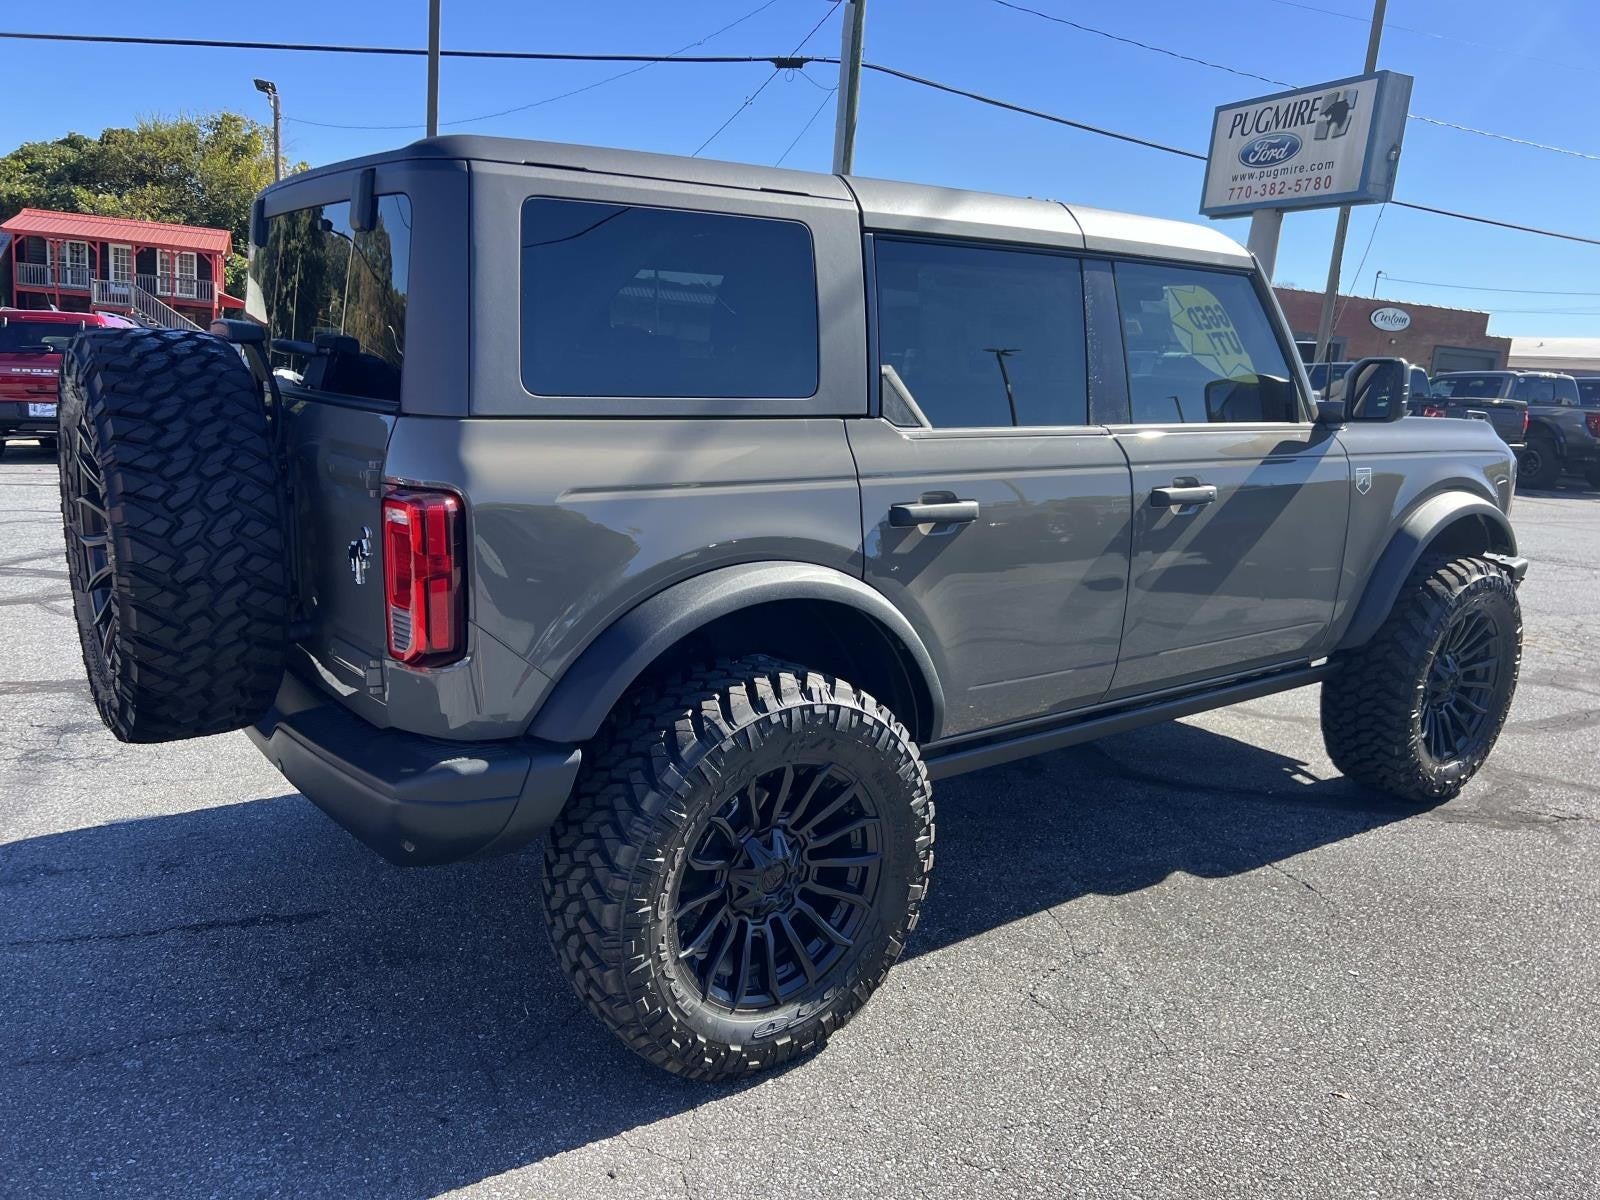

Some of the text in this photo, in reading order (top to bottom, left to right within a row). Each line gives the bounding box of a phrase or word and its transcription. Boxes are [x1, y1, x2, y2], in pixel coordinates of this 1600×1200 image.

[1228, 97, 1322, 139] PUGMIRE
[1249, 138, 1289, 163] Ford
[1231, 160, 1334, 182] www.pugmire.com
[1228, 175, 1332, 200] 770-382-5780
